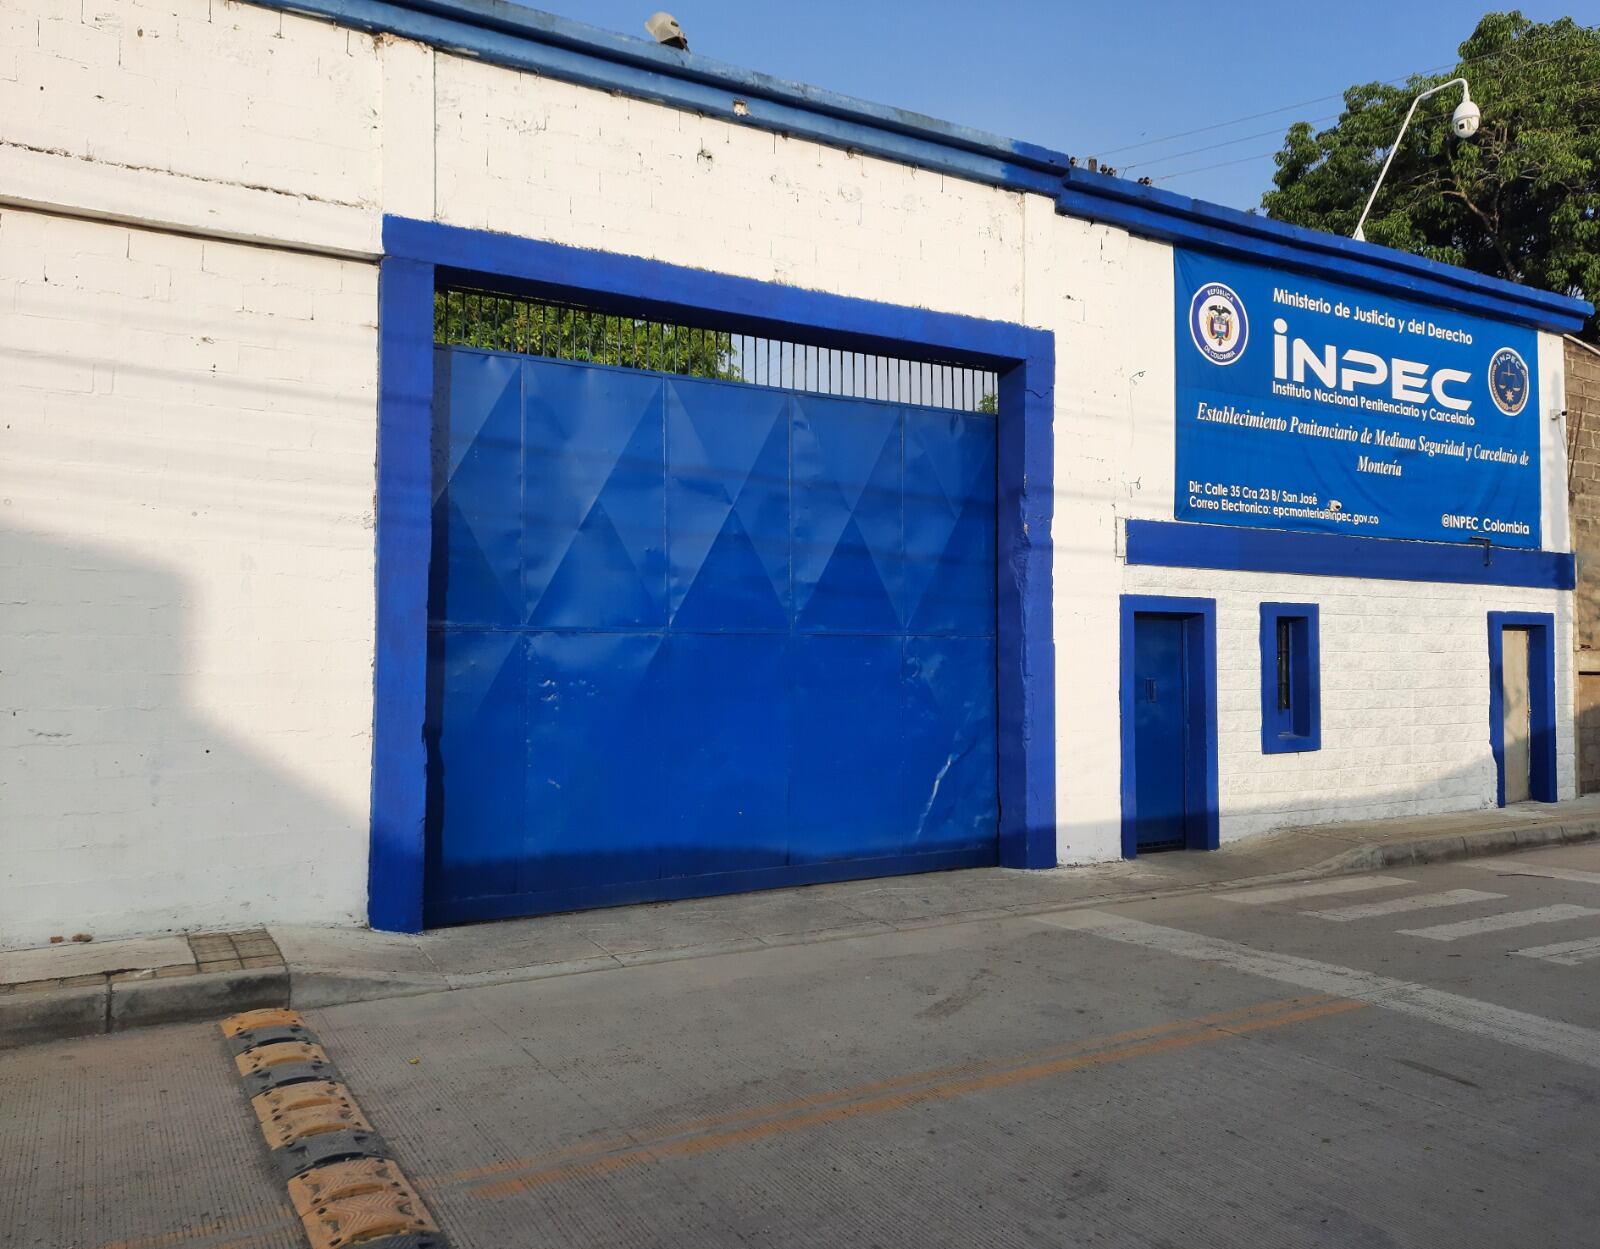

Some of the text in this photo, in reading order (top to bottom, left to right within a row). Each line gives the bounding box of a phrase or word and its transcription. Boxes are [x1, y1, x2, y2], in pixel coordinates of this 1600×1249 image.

[1273, 288, 1472, 345] Ministerio de Justicia y del Derecho
[1272, 381, 1475, 426] Instituto Nacional Penitenciario y Carcelario
[1197, 402, 1529, 466] Establecimiento Penitenciario de Mediana Seguridad y Carcelario de
[1357, 456, 1402, 476] Montería
[1190, 481, 1318, 505] Dir: Calle 35 Cra 23 B/ San José
[1190, 496, 1219, 510] Correo
[1222, 498, 1271, 515] Electronico:
[1442, 514, 1529, 535] @INPEC_Colombia
